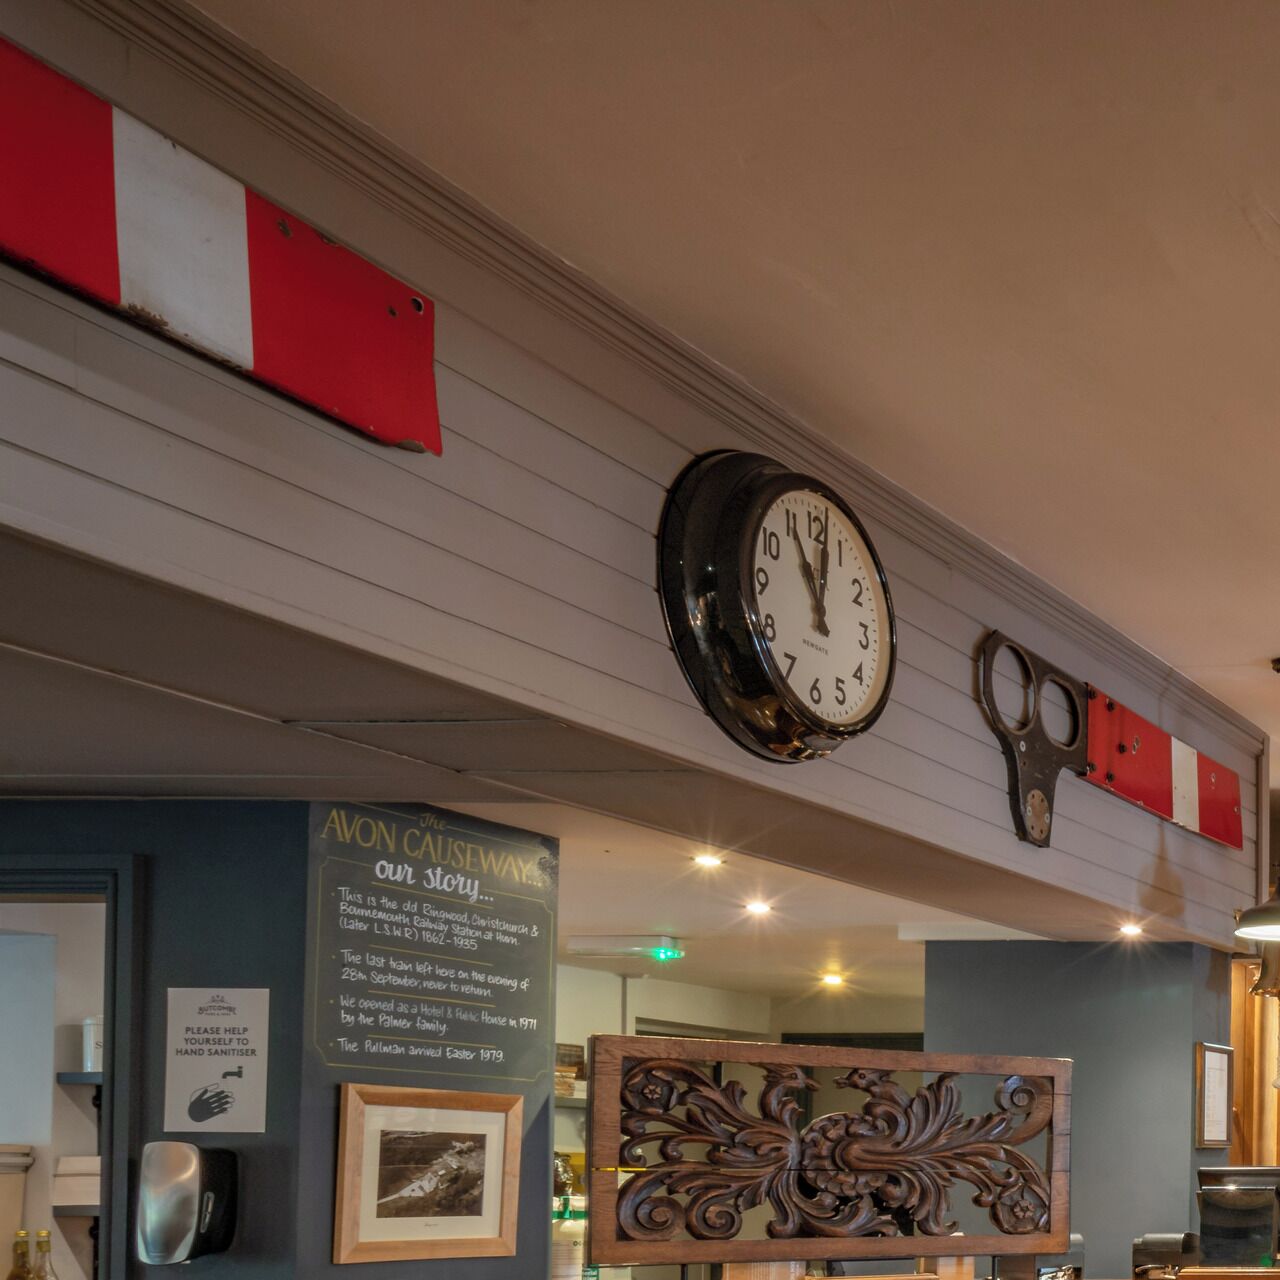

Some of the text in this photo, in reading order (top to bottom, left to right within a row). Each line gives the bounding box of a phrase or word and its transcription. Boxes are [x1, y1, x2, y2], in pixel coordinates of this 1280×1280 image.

[807, 510, 826, 546] 12
[762, 526, 780, 561] 10
[837, 539, 843, 568] 1
[756, 567, 770, 596] 9
[851, 578, 864, 608] 2
[763, 614, 776, 643] 8
[858, 622, 870, 650] 3
[802, 638, 829, 656] NEWGATE
[783, 652, 797, 681] 7
[852, 661, 864, 687] 4
[809, 678, 822, 705] 6
[834, 677, 847, 705] 5
[320, 807, 397, 853] AVON
[418, 812, 447, 830] The
[375, 859, 494, 904] our story...
[338, 887, 539, 938] This is the old Ringwood, Christchurch &
[339, 918, 369, 935] (Later
[340, 904, 410, 926] Bournemouth
[413, 915, 449, 934] Railway
[451, 922, 482, 940] Station
[483, 929, 493, 942] at
[341, 949, 530, 992] The last train left here on the evening of
[423, 979, 449, 991] never
[450, 981, 460, 991] to
[340, 995, 356, 1009] We
[358, 997, 395, 1015] opened
[397, 1002, 410, 1014] as
[411, 1002, 419, 1014] a
[420, 1001, 444, 1017] Hotel
[481, 1010, 507, 1026] House
[508, 1016, 517, 1027] in
[519, 1017, 537, 1030] 1971
[340, 1011, 355, 1027] by
[358, 1012, 375, 1026] the
[378, 1016, 412, 1030] Palmer
[184, 1037, 249, 1046] YOURSELF TO
[185, 1026, 249, 1035] PLEASE HELP
[176, 1048, 257, 1057] HAND SANITISER
[338, 1038, 359, 1053] The
[365, 1039, 405, 1055] Pullman
[408, 1044, 442, 1058] arrived
[446, 1045, 475, 1060] Easter
